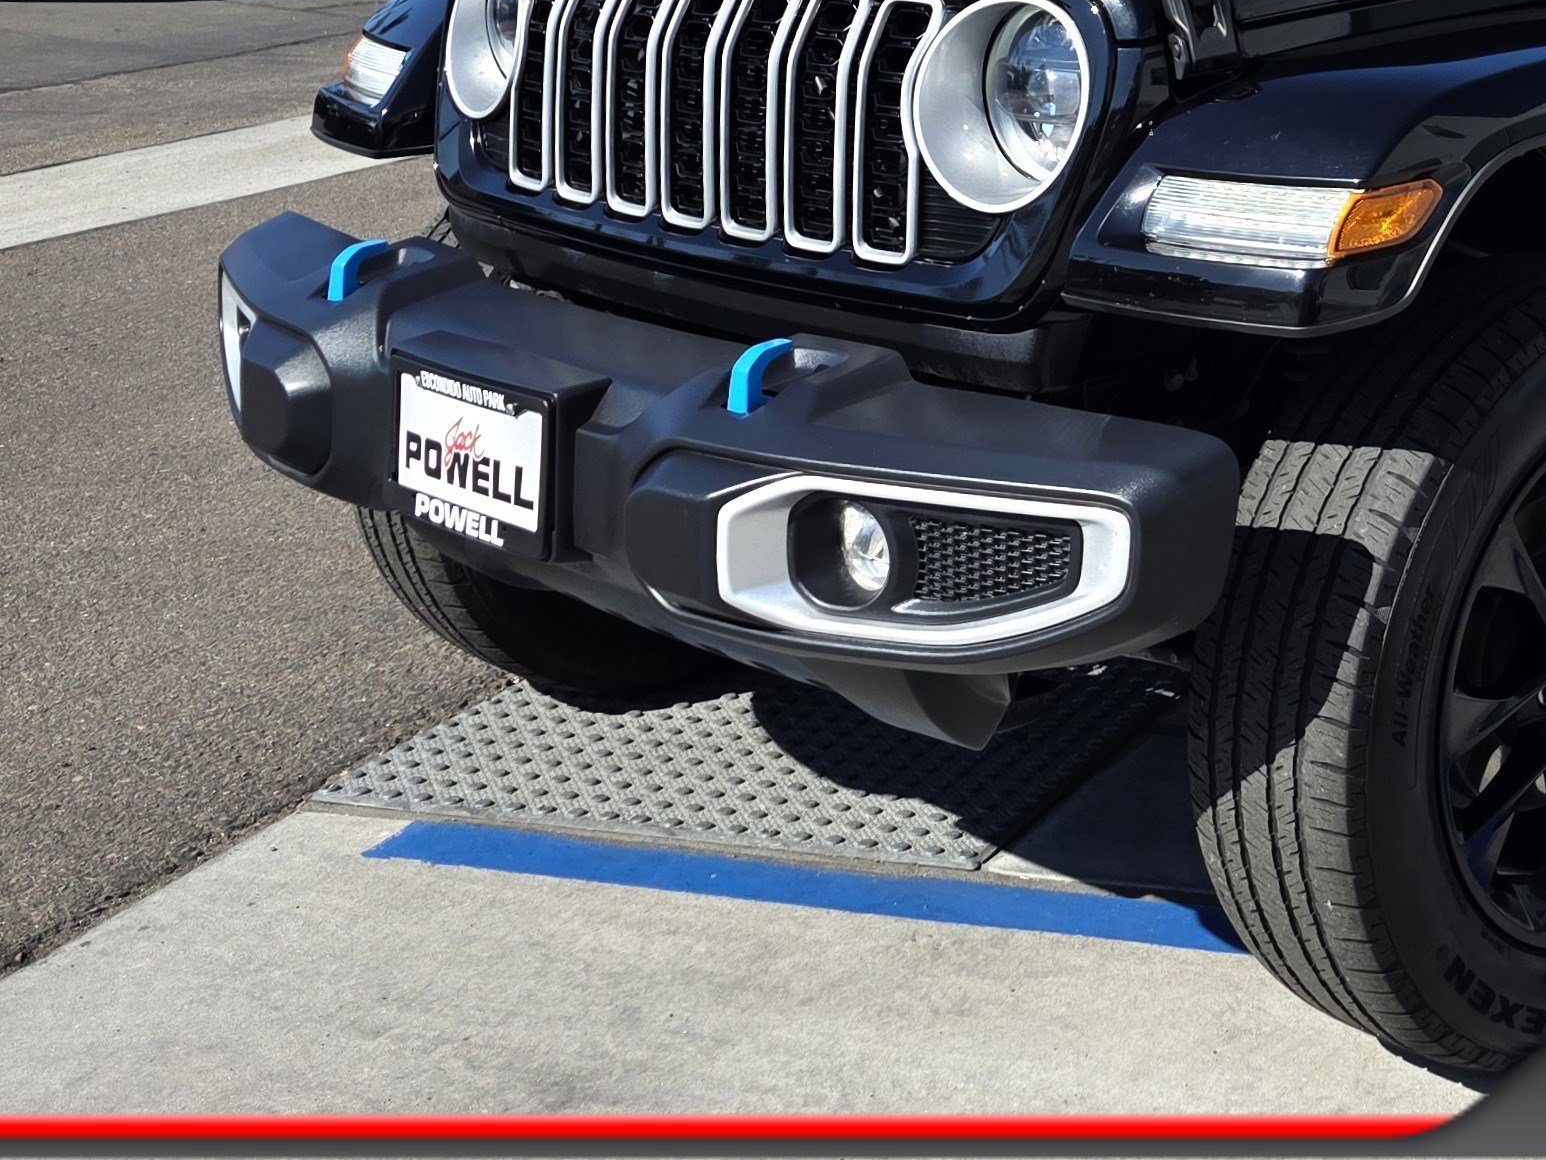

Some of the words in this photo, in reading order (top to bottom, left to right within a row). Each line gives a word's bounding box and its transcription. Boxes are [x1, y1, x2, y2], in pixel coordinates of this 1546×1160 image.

[462, 383, 483, 406] AUTO
[483, 389, 506, 412] PARK
[444, 416, 485, 467] Jack
[405, 430, 534, 510] POWELL
[415, 492, 504, 547] POWELL
